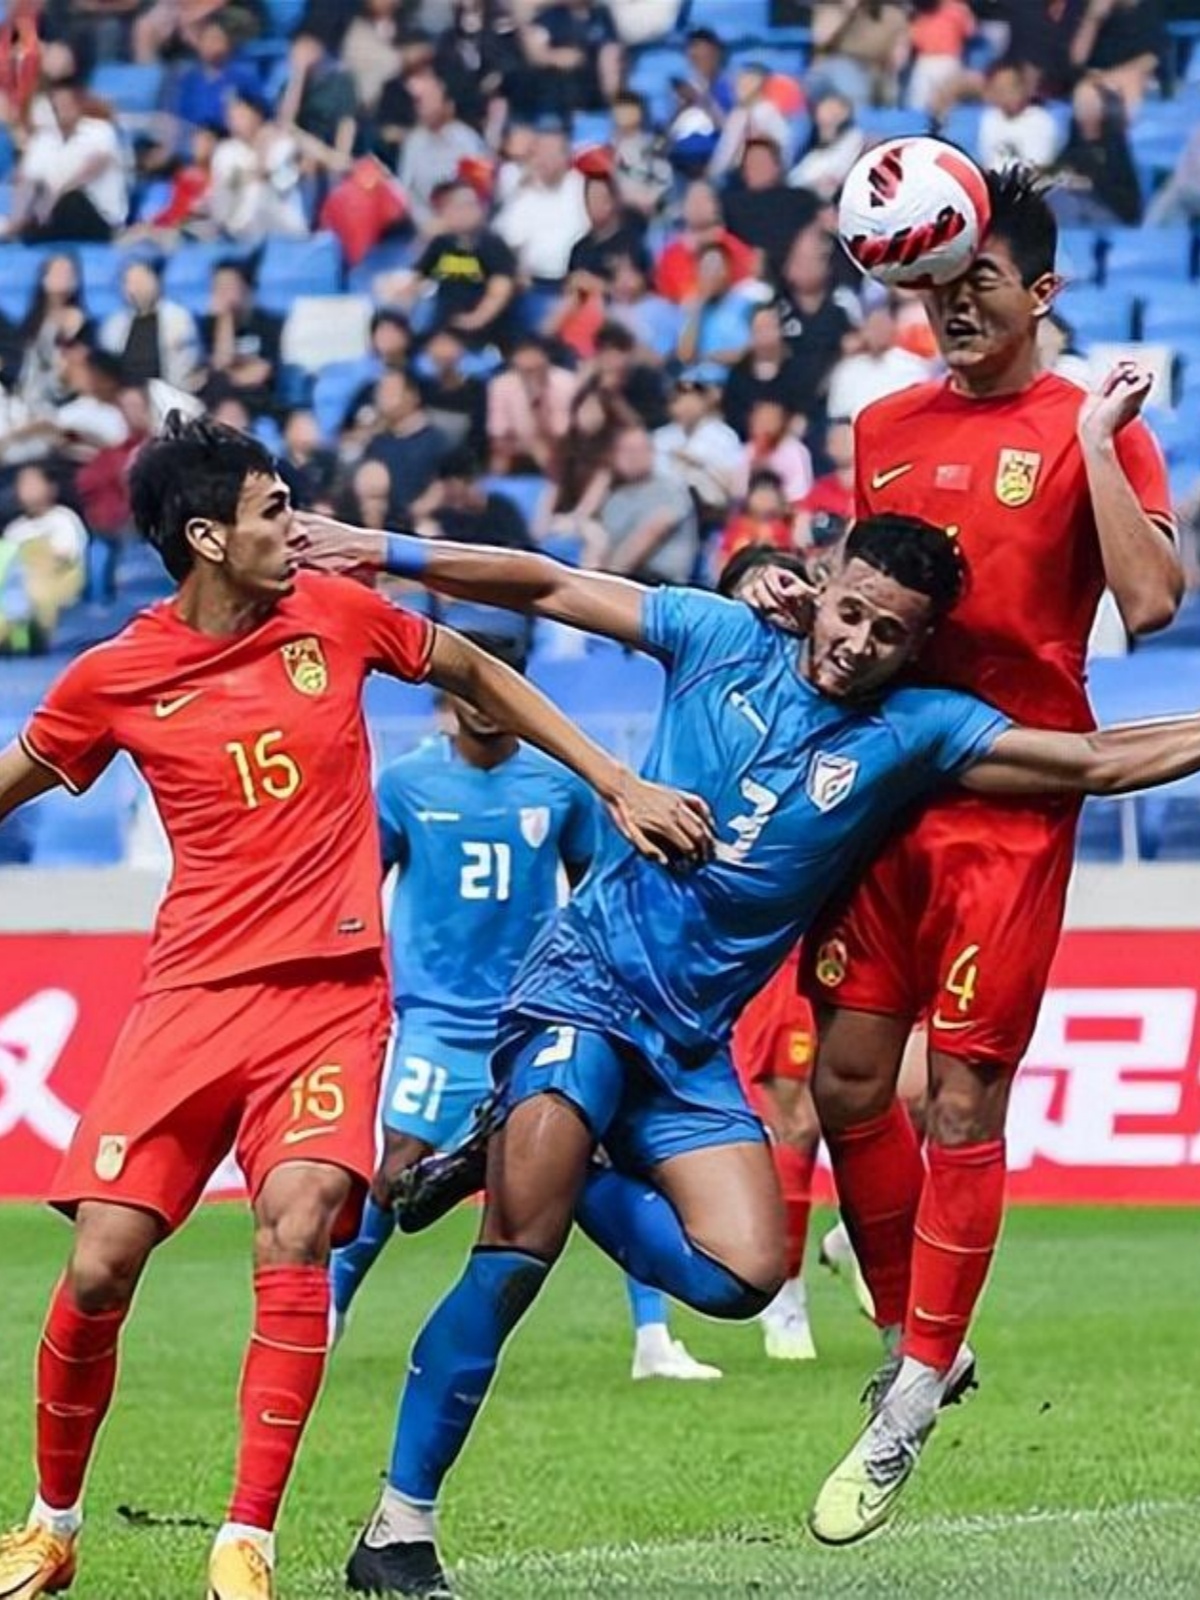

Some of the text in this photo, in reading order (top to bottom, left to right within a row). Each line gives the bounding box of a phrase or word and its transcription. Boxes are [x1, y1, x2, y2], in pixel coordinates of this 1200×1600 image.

[225, 730, 300, 809] 15
[460, 841, 511, 901] 21
[945, 944, 980, 1012] 4
[289, 1064, 344, 1121] 15
[392, 1056, 447, 1122] 21
[1006, 986, 1197, 1173] 足
